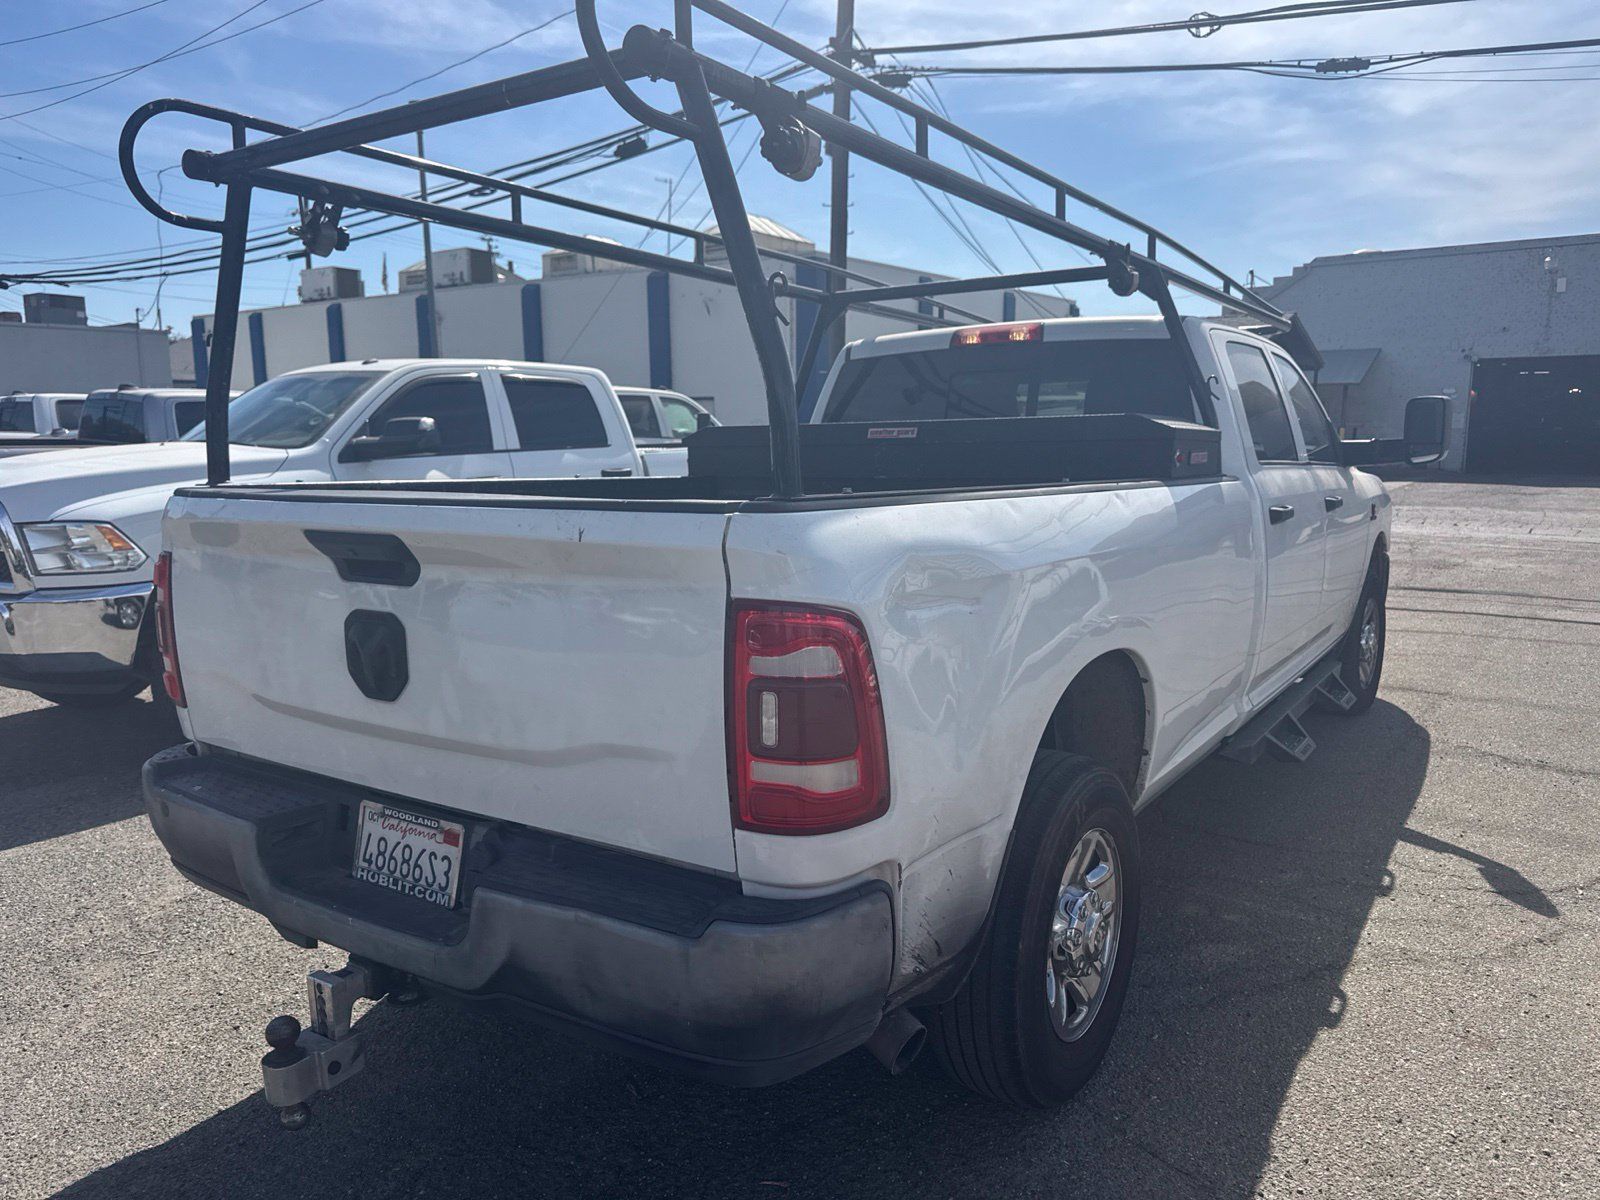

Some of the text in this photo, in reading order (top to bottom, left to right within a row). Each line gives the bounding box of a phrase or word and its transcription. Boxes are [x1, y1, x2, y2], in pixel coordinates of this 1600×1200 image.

[381, 816, 444, 845] California
[384, 807, 439, 828] WOODLAND
[362, 832, 452, 892] 48686S3
[357, 867, 449, 907] HOBLIT.COM
